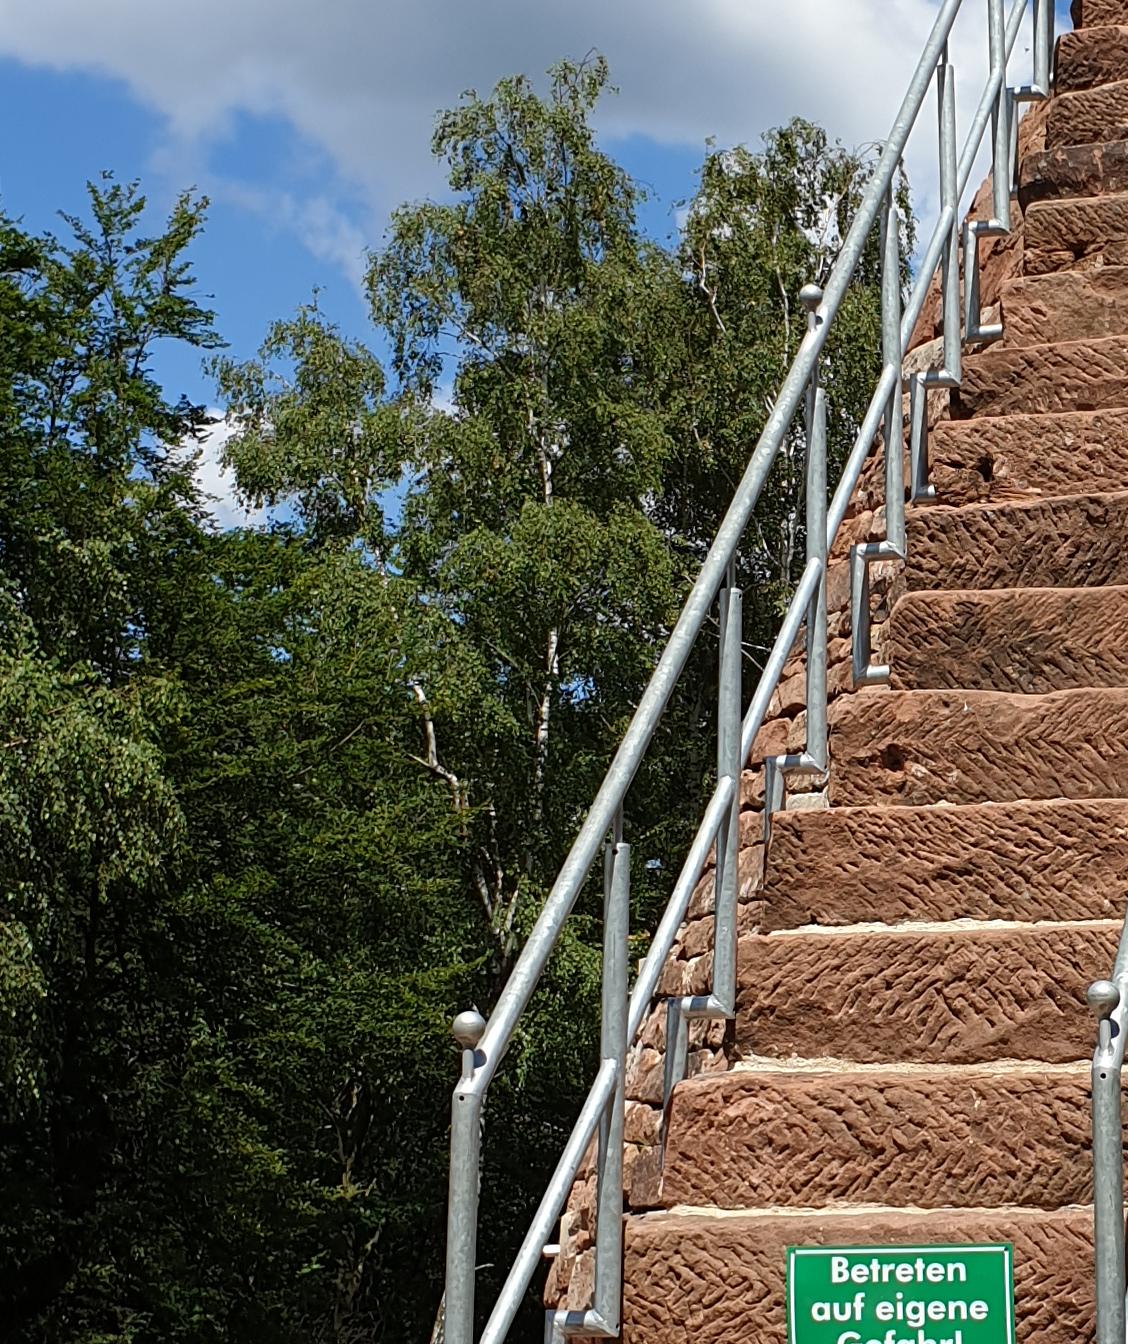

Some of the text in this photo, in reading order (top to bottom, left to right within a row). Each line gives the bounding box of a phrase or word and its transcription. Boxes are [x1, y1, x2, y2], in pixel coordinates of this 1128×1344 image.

[831, 1256, 967, 1283] Betreten
[811, 1292, 989, 1327] auf eigene
